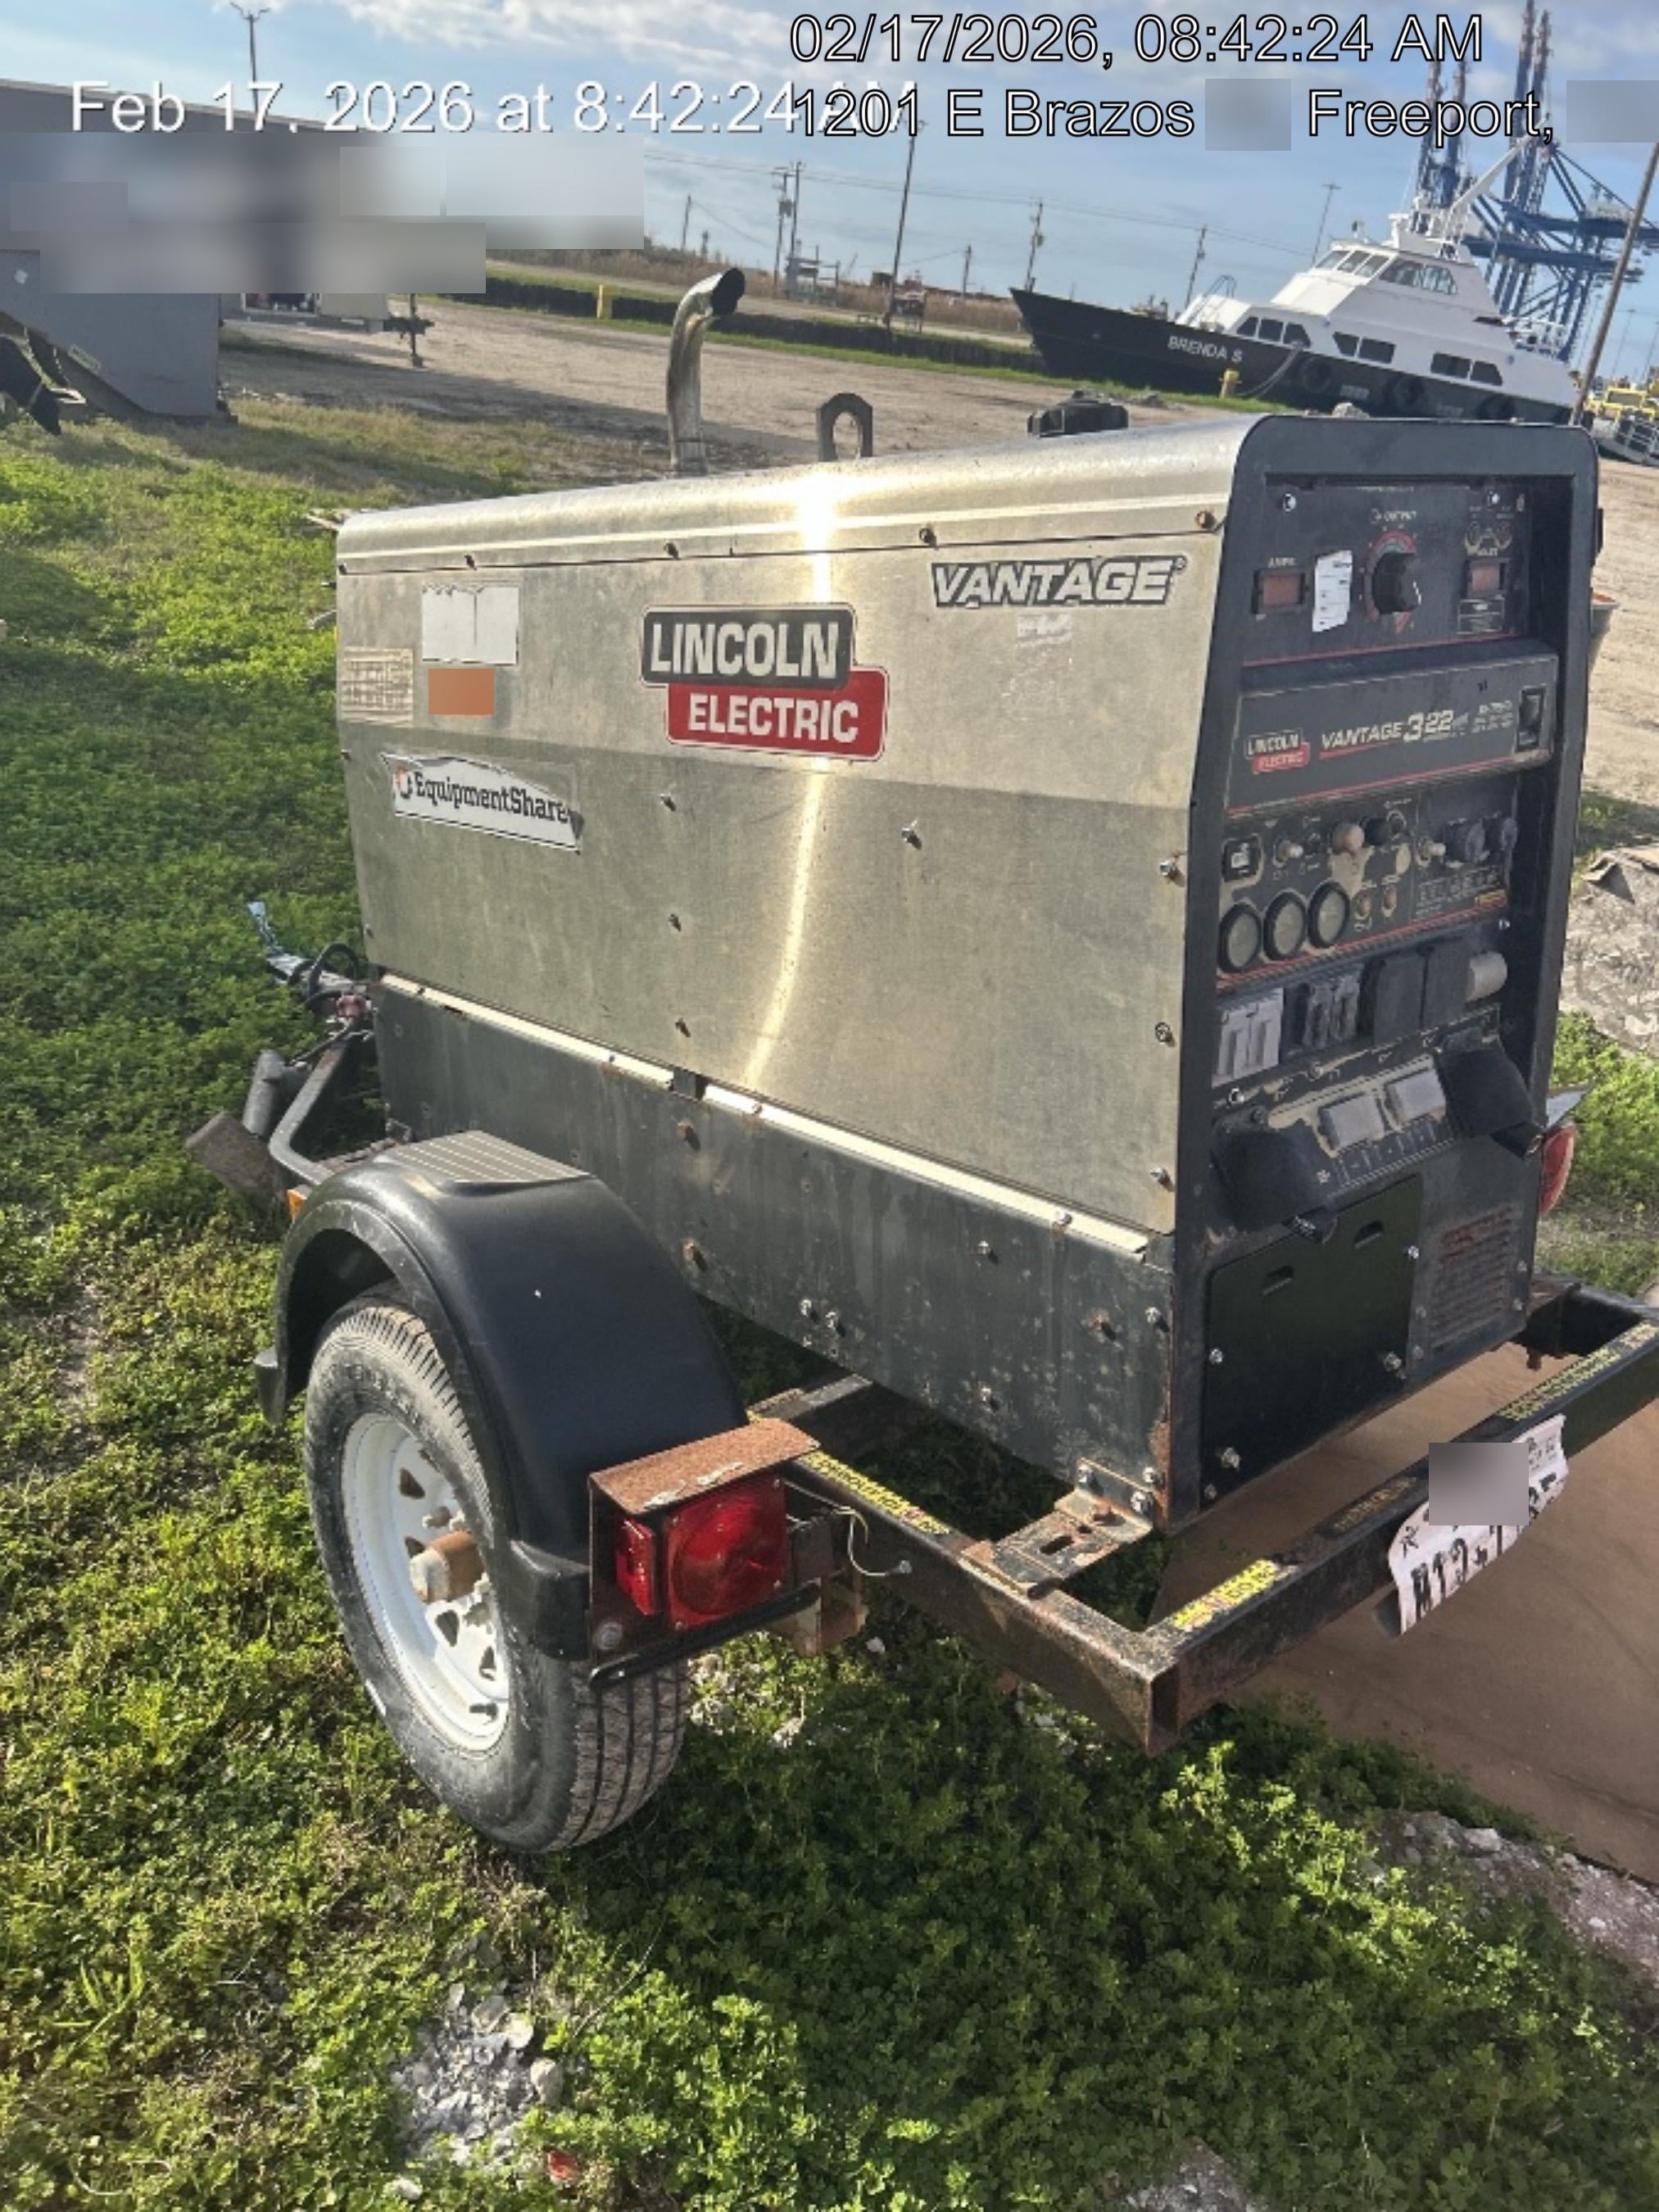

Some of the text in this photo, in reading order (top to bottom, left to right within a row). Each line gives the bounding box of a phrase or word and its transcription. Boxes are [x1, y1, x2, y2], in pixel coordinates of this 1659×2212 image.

[1167, 335, 1243, 363] BRENDA S
[932, 557, 1175, 606] VANTAGE
[650, 622, 840, 679] LINCOLN
[688, 692, 859, 744] ELECTRIC
[1321, 722, 1403, 750] VANTAGE
[1403, 709, 1455, 742] 322
[1247, 732, 1299, 755] LINCOLN
[414, 771, 570, 823] EquipmentShare
